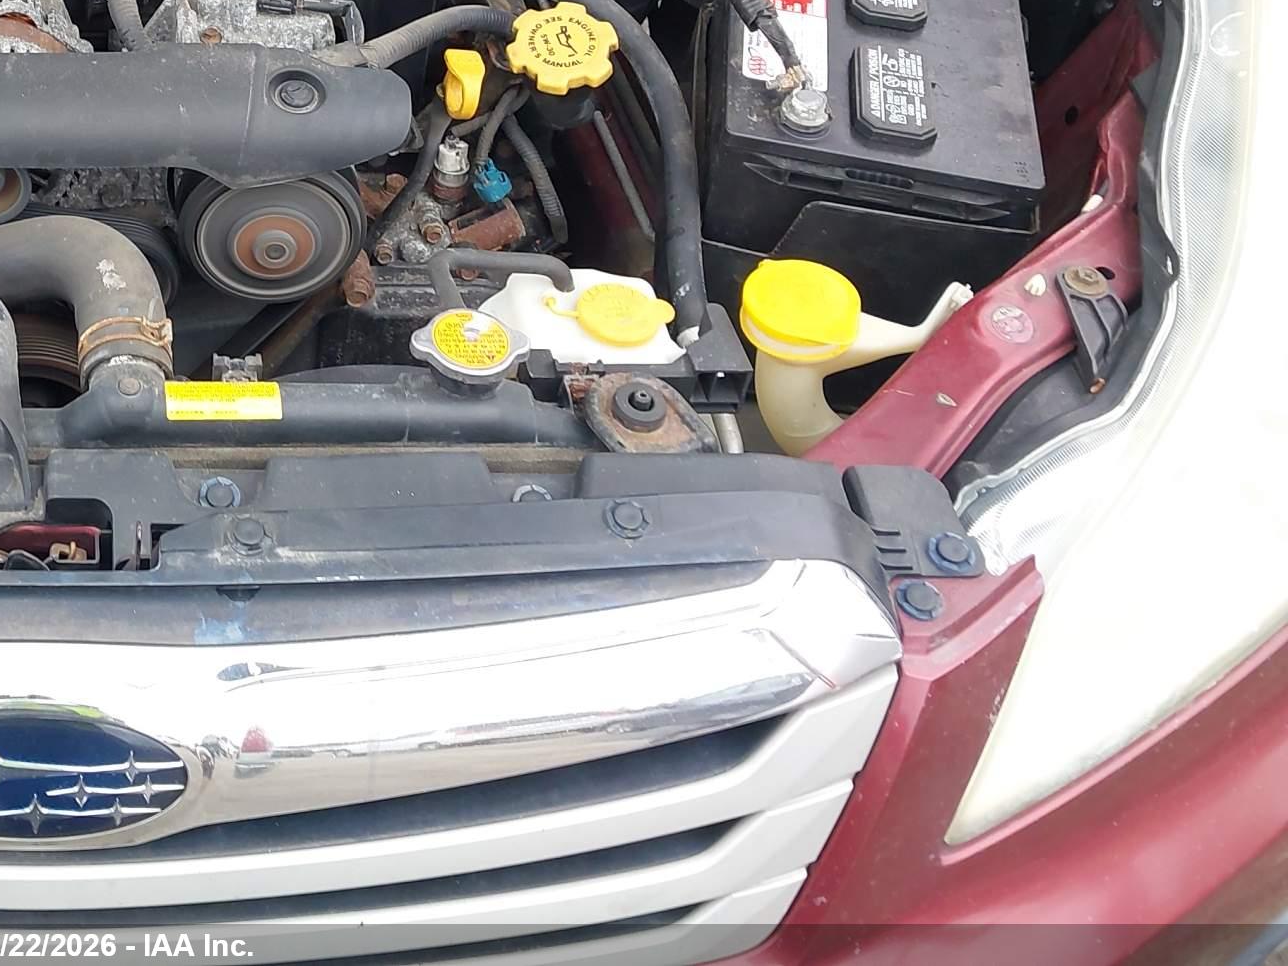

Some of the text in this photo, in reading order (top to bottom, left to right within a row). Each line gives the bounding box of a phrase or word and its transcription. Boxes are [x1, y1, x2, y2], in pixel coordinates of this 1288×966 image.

[544, 16, 563, 25] SEE
[540, 33, 556, 57] 5W-30
[568, 17, 597, 56] ENGINE OIL
[542, 58, 583, 68] MANUAL
